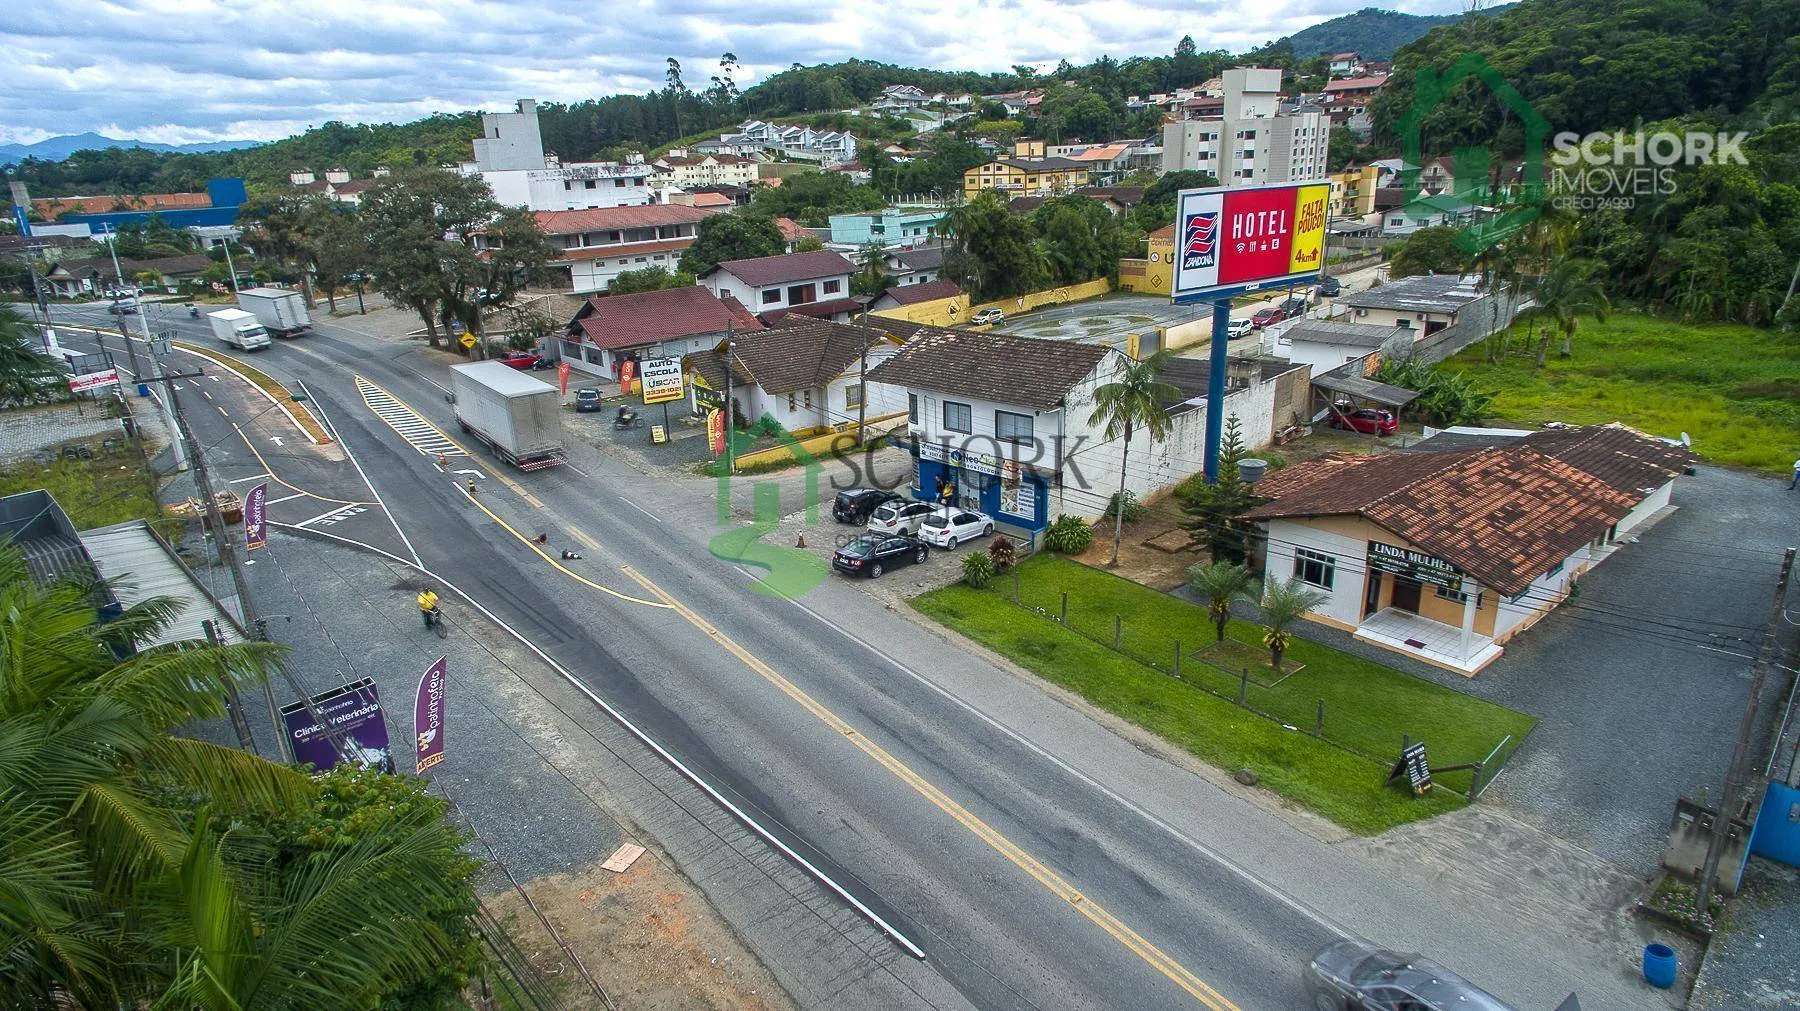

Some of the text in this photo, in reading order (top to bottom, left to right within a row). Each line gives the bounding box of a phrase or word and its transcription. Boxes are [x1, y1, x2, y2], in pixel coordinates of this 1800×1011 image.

[1301, 199, 1323, 217] FALTA
[1232, 210, 1287, 239] HOTEL
[1295, 249, 1313, 264] 4km
[644, 368, 679, 377] ESCOLA
[648, 360, 673, 368] AUTO
[1374, 543, 1406, 560] LINDA
[429, 670, 441, 729] patinhofeio
[328, 702, 379, 726] Veterinária
